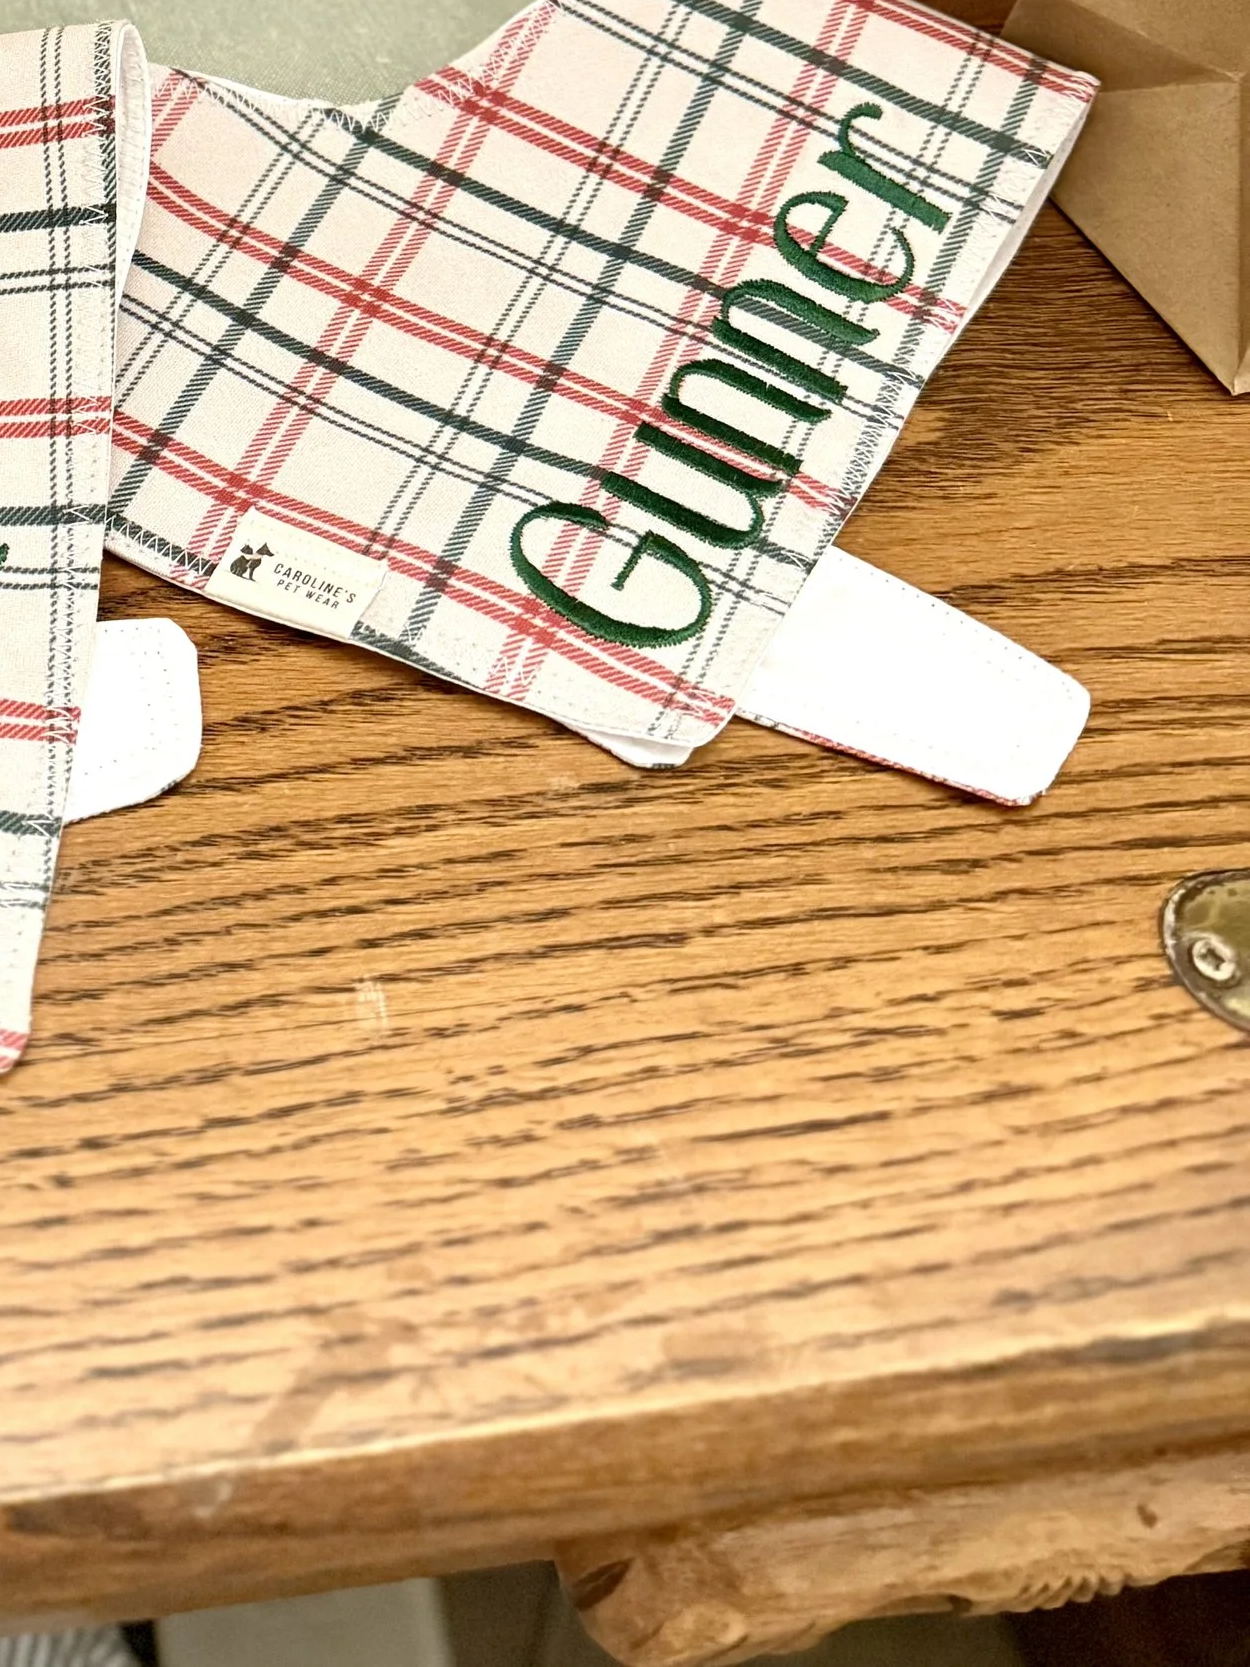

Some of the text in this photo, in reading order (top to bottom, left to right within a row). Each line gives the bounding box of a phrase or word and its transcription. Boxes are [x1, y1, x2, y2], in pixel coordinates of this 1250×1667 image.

[510, 101, 953, 649] Gunner
[273, 562, 357, 604] CAROLINE'S
[276, 579, 340, 610] PET WEAR
